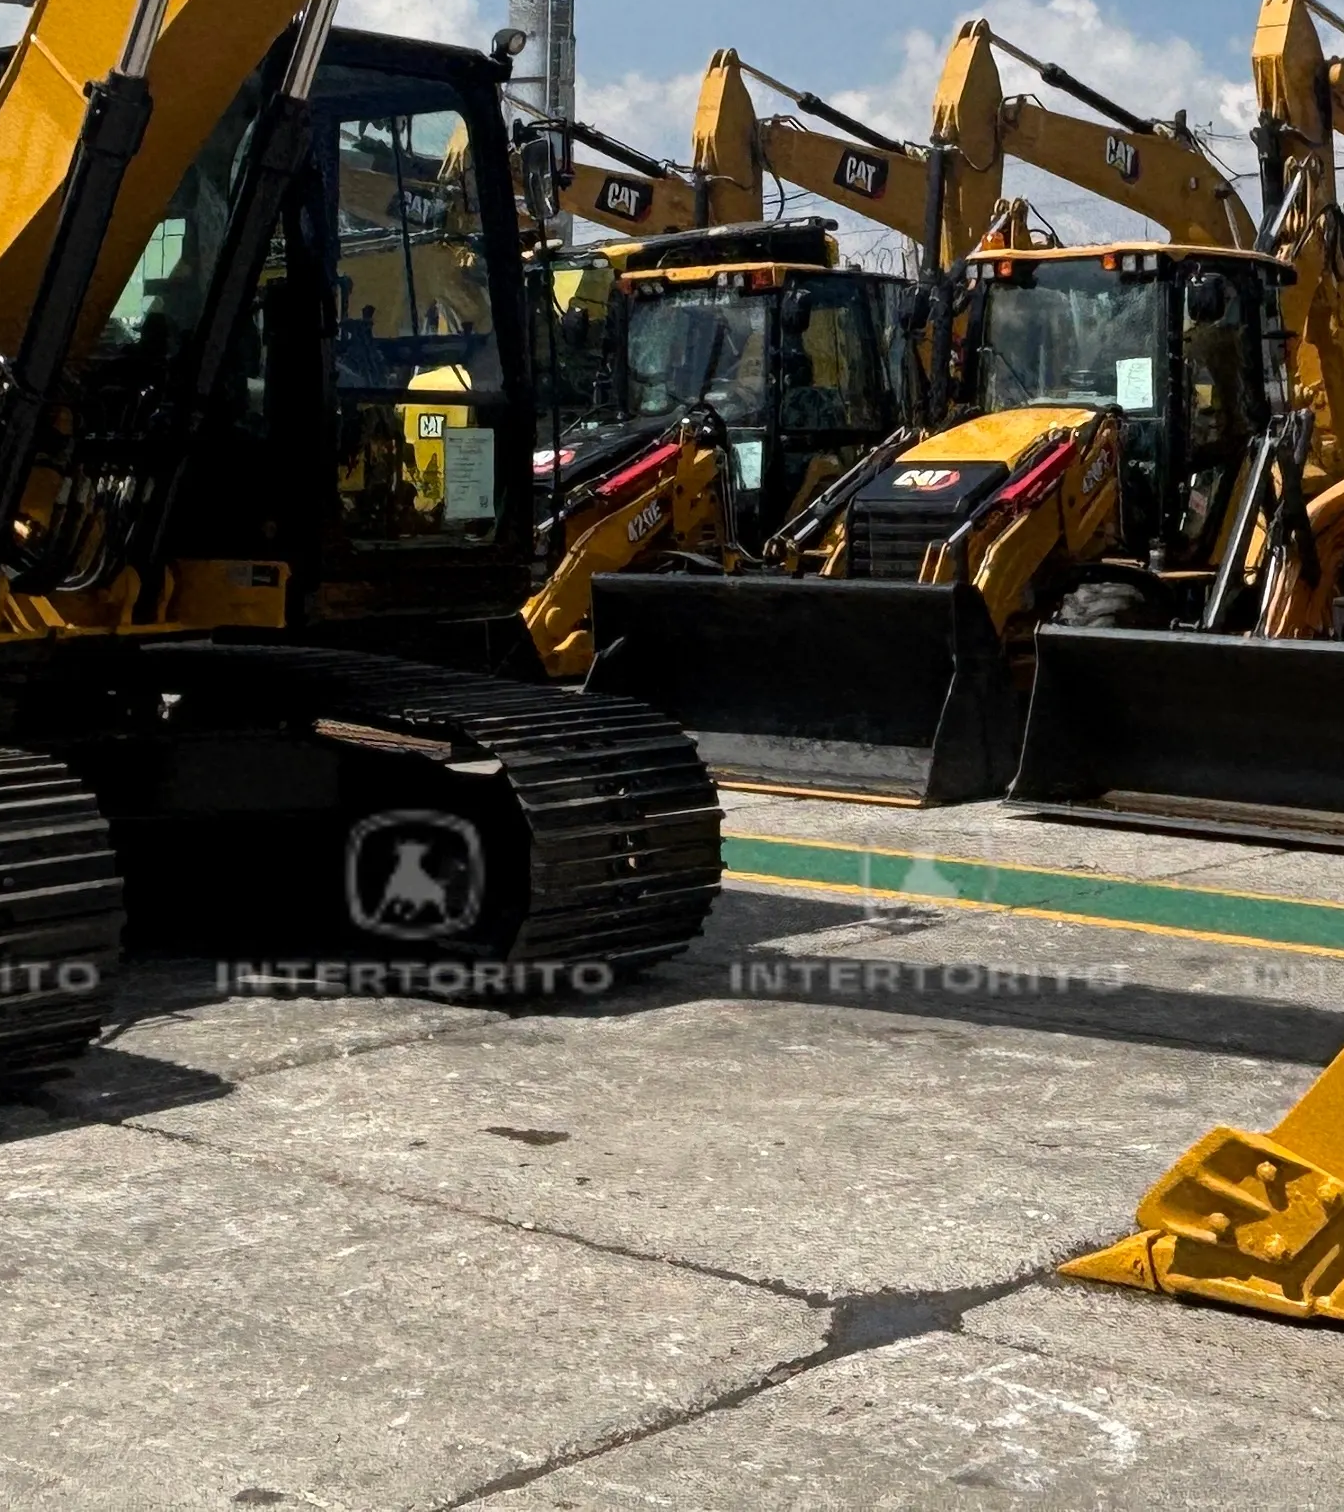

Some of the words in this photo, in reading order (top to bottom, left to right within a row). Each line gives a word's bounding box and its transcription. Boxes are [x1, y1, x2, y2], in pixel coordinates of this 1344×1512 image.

[845, 155, 876, 193] CAT
[1106, 135, 1135, 175] CAT
[606, 182, 641, 217] CAT
